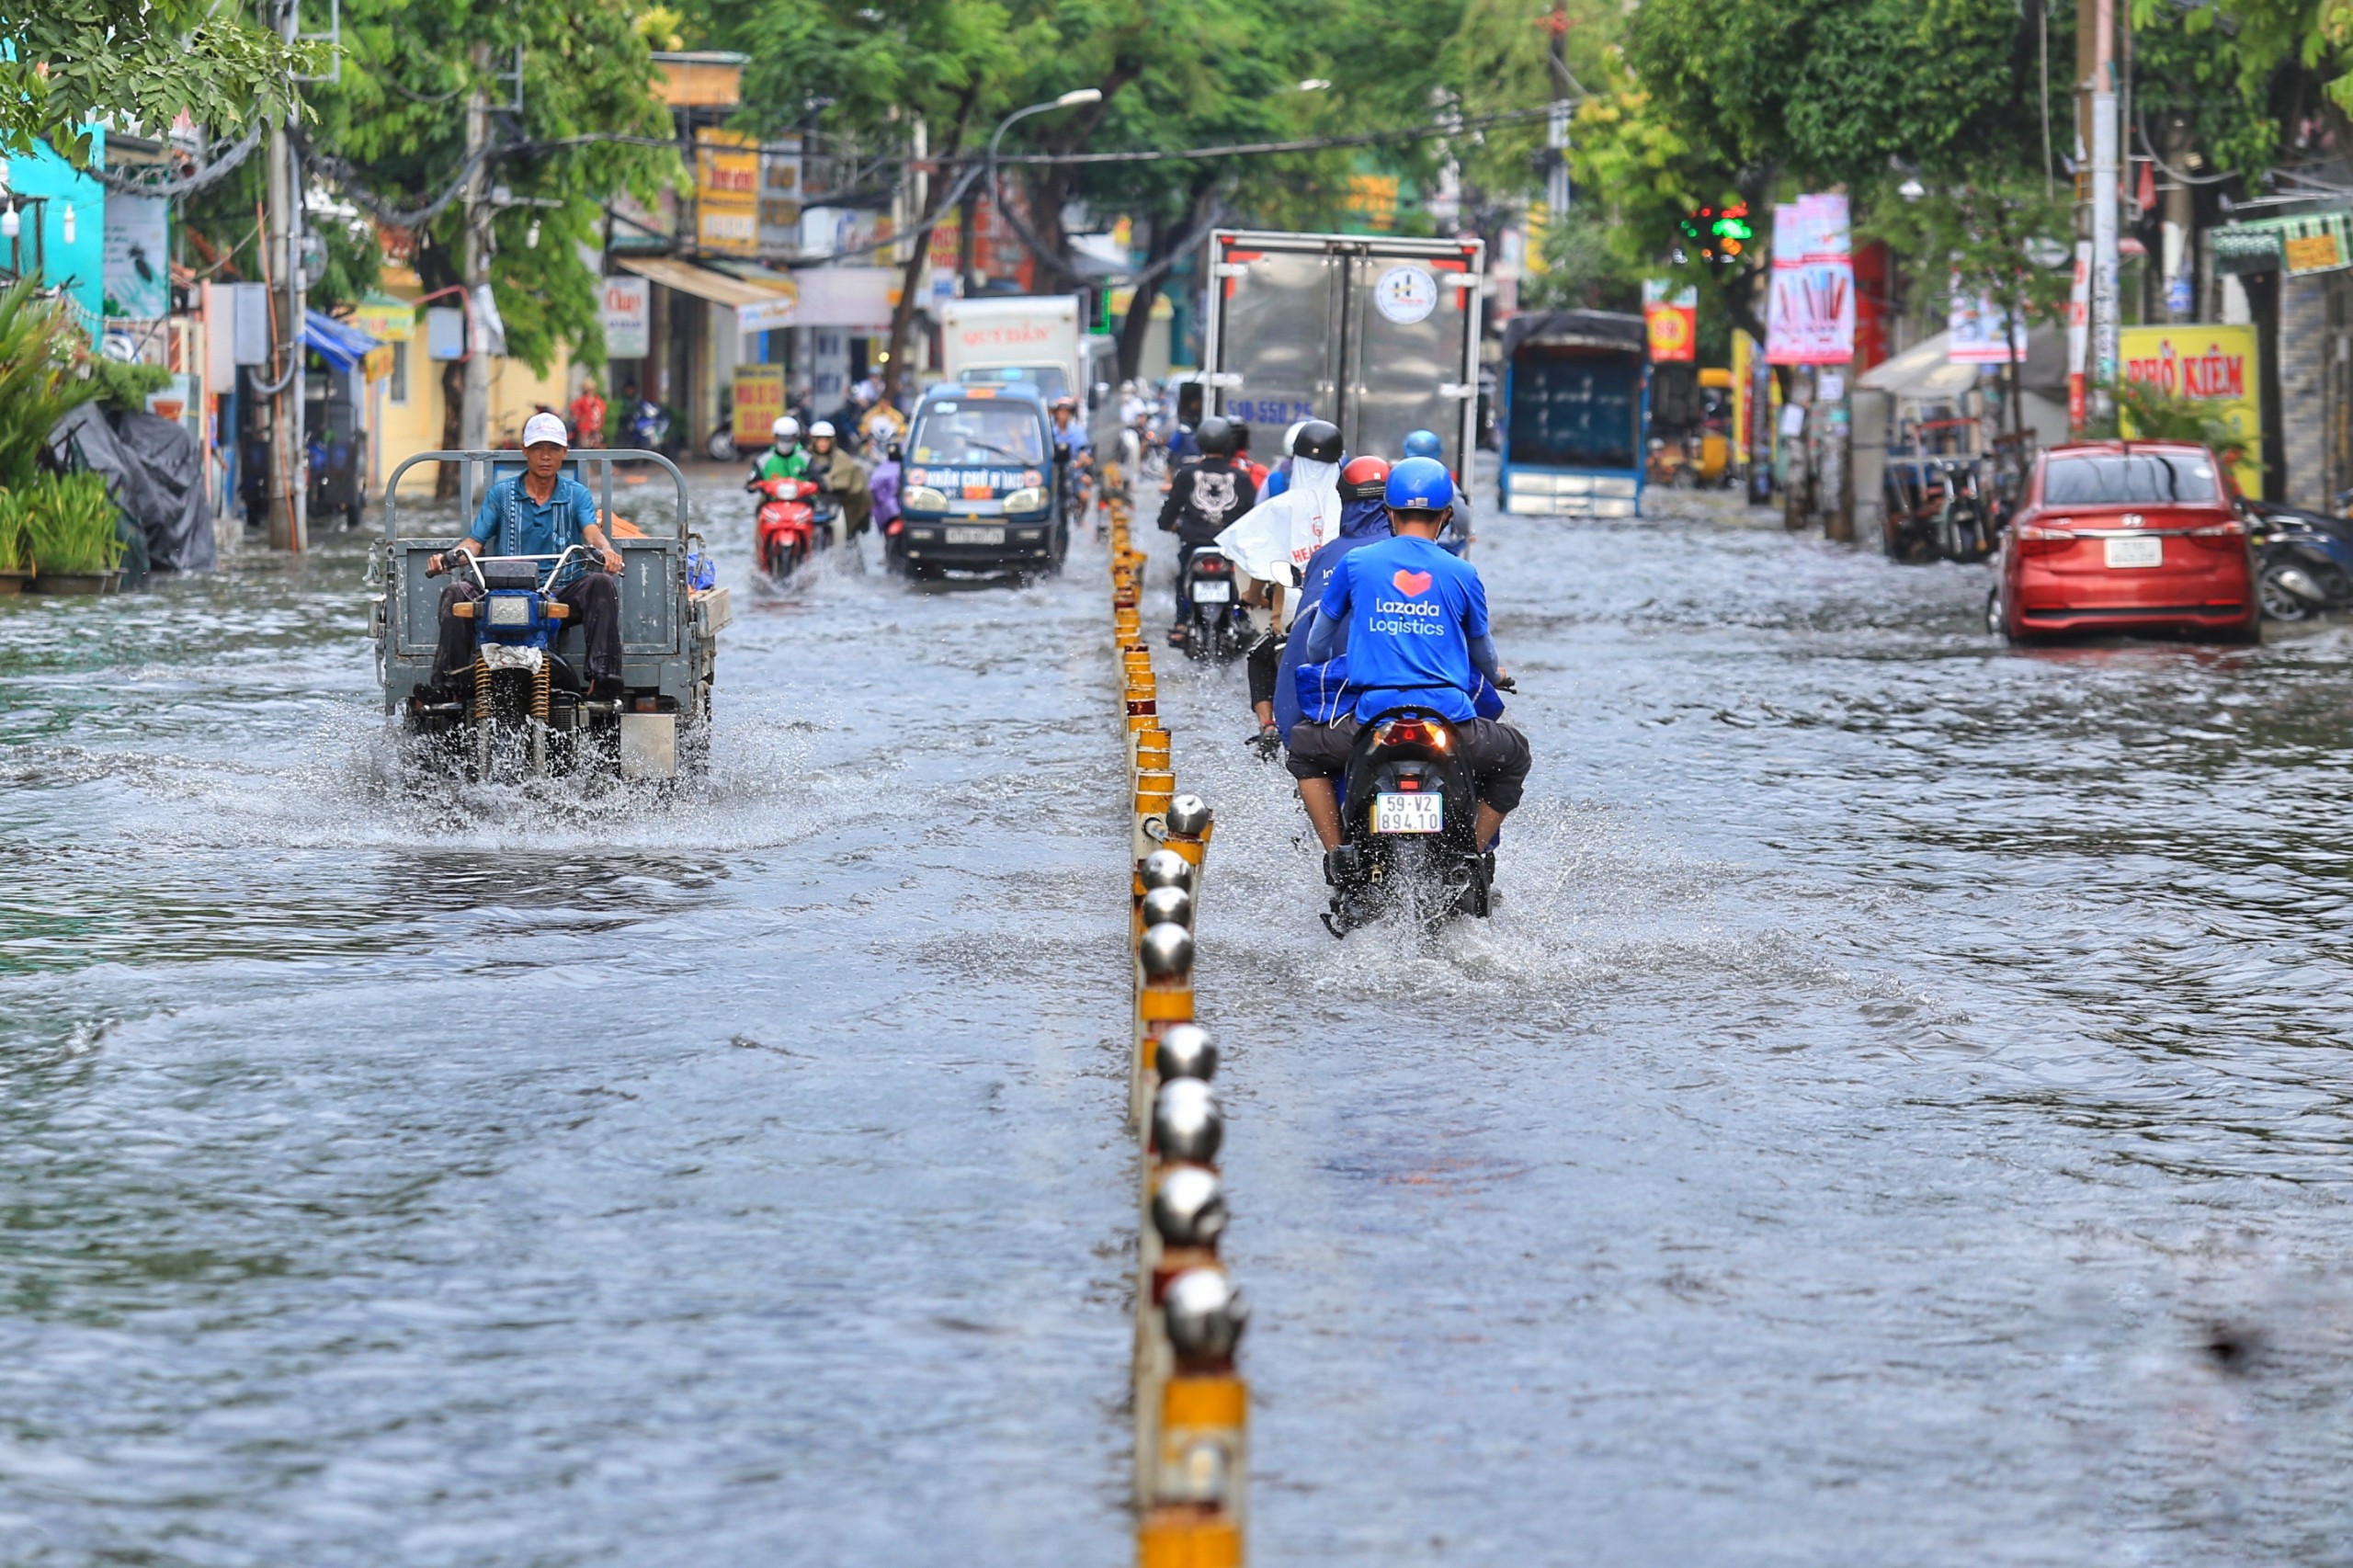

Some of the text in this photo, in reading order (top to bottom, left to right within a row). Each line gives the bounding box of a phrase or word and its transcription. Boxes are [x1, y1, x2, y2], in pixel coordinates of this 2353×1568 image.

[1376, 597, 1440, 617] Lazada
[1369, 617, 1445, 636] Logistics
[1381, 813, 1438, 830] 894.10
